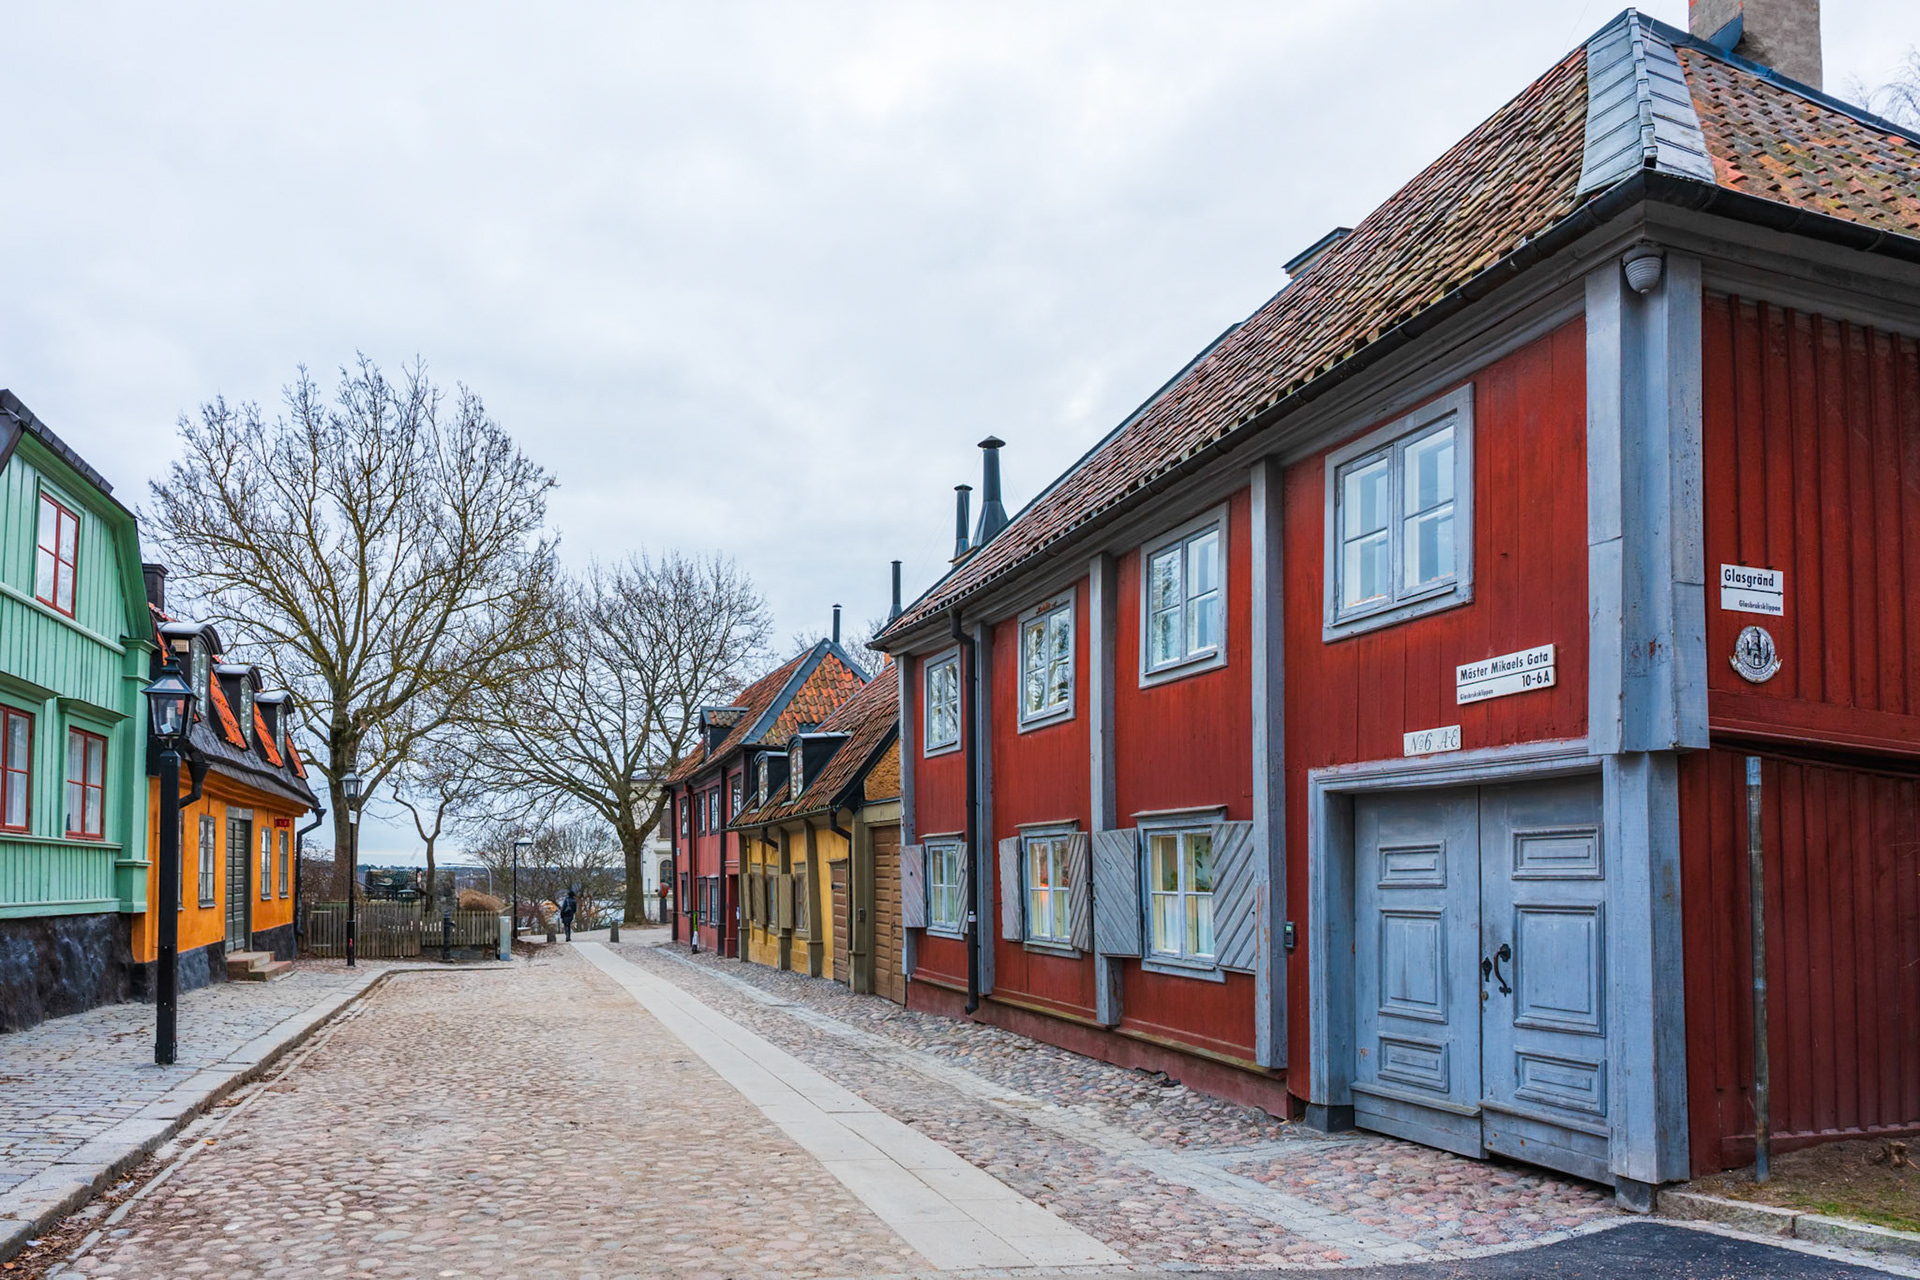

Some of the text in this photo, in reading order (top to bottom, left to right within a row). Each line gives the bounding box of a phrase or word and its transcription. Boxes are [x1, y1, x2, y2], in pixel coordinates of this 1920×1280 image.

[1725, 569, 1774, 587] Glasgränd
[1460, 652, 1548, 681] Mäster Mikaels Gata
